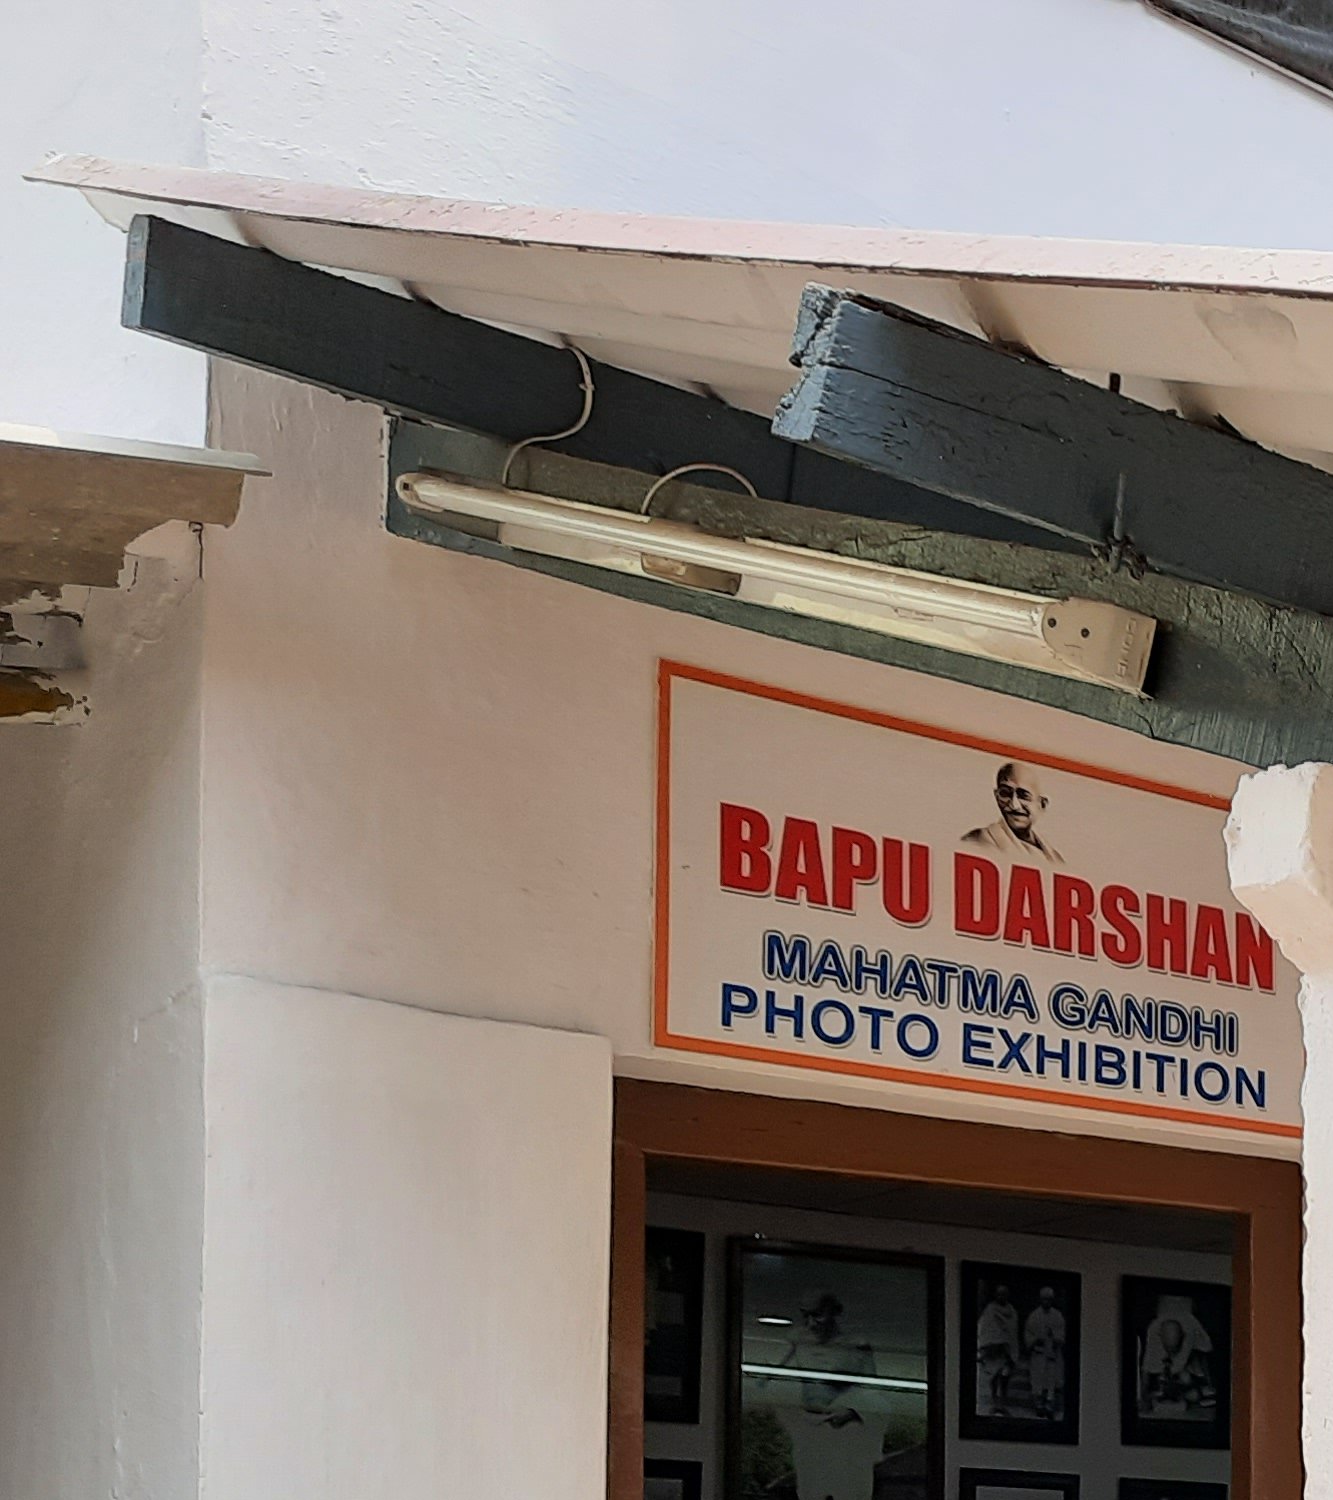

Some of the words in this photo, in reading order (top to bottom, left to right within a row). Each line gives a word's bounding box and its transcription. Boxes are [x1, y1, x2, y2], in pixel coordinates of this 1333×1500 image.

[719, 802, 930, 926] BAPU
[954, 851, 1274, 993] DARSHAN
[721, 982, 939, 1060] PHOTO
[962, 1027, 1267, 1109] EXHIBITION
[763, 931, 1039, 1022] MAHATMA
[1048, 982, 1240, 1056] GANDHI
